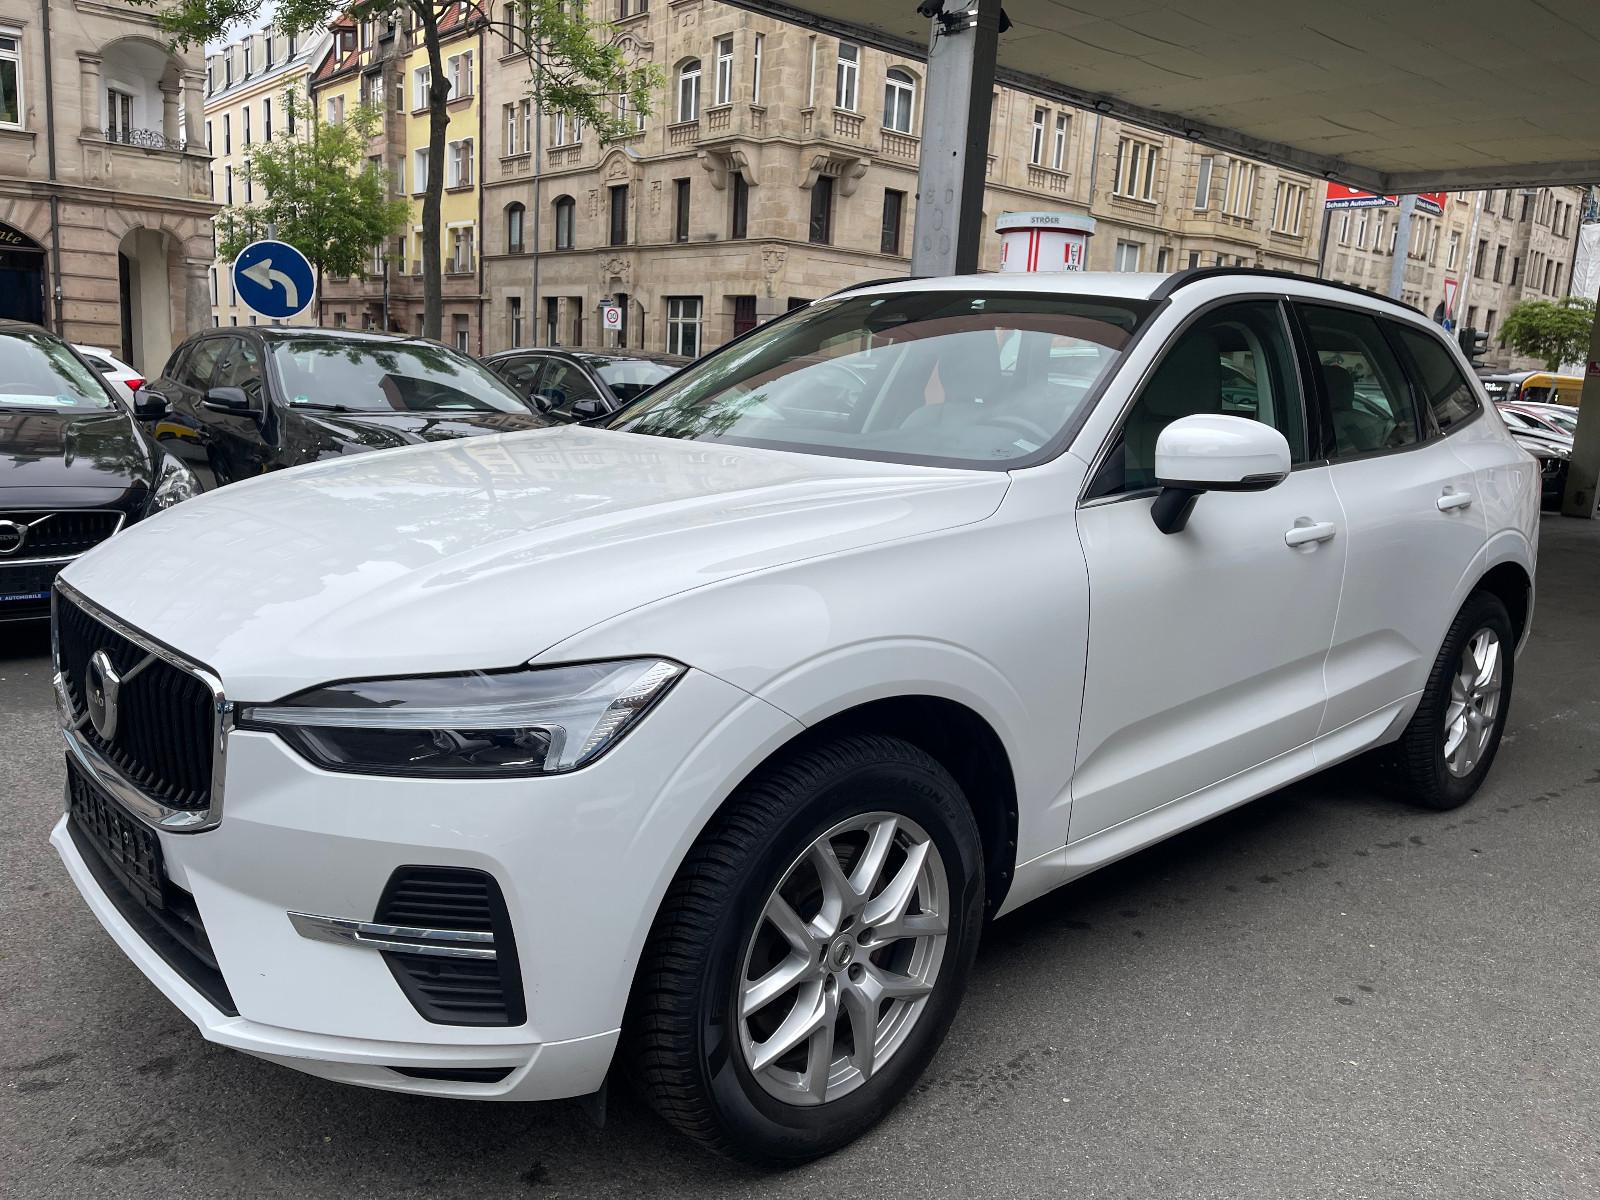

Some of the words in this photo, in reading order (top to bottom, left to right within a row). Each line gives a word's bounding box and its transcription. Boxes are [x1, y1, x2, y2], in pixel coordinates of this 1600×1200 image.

[1350, 199, 1385, 207] Automobile
[1066, 264, 1079, 272] KFC
[5, 593, 42, 601] AUTOMOBILE
